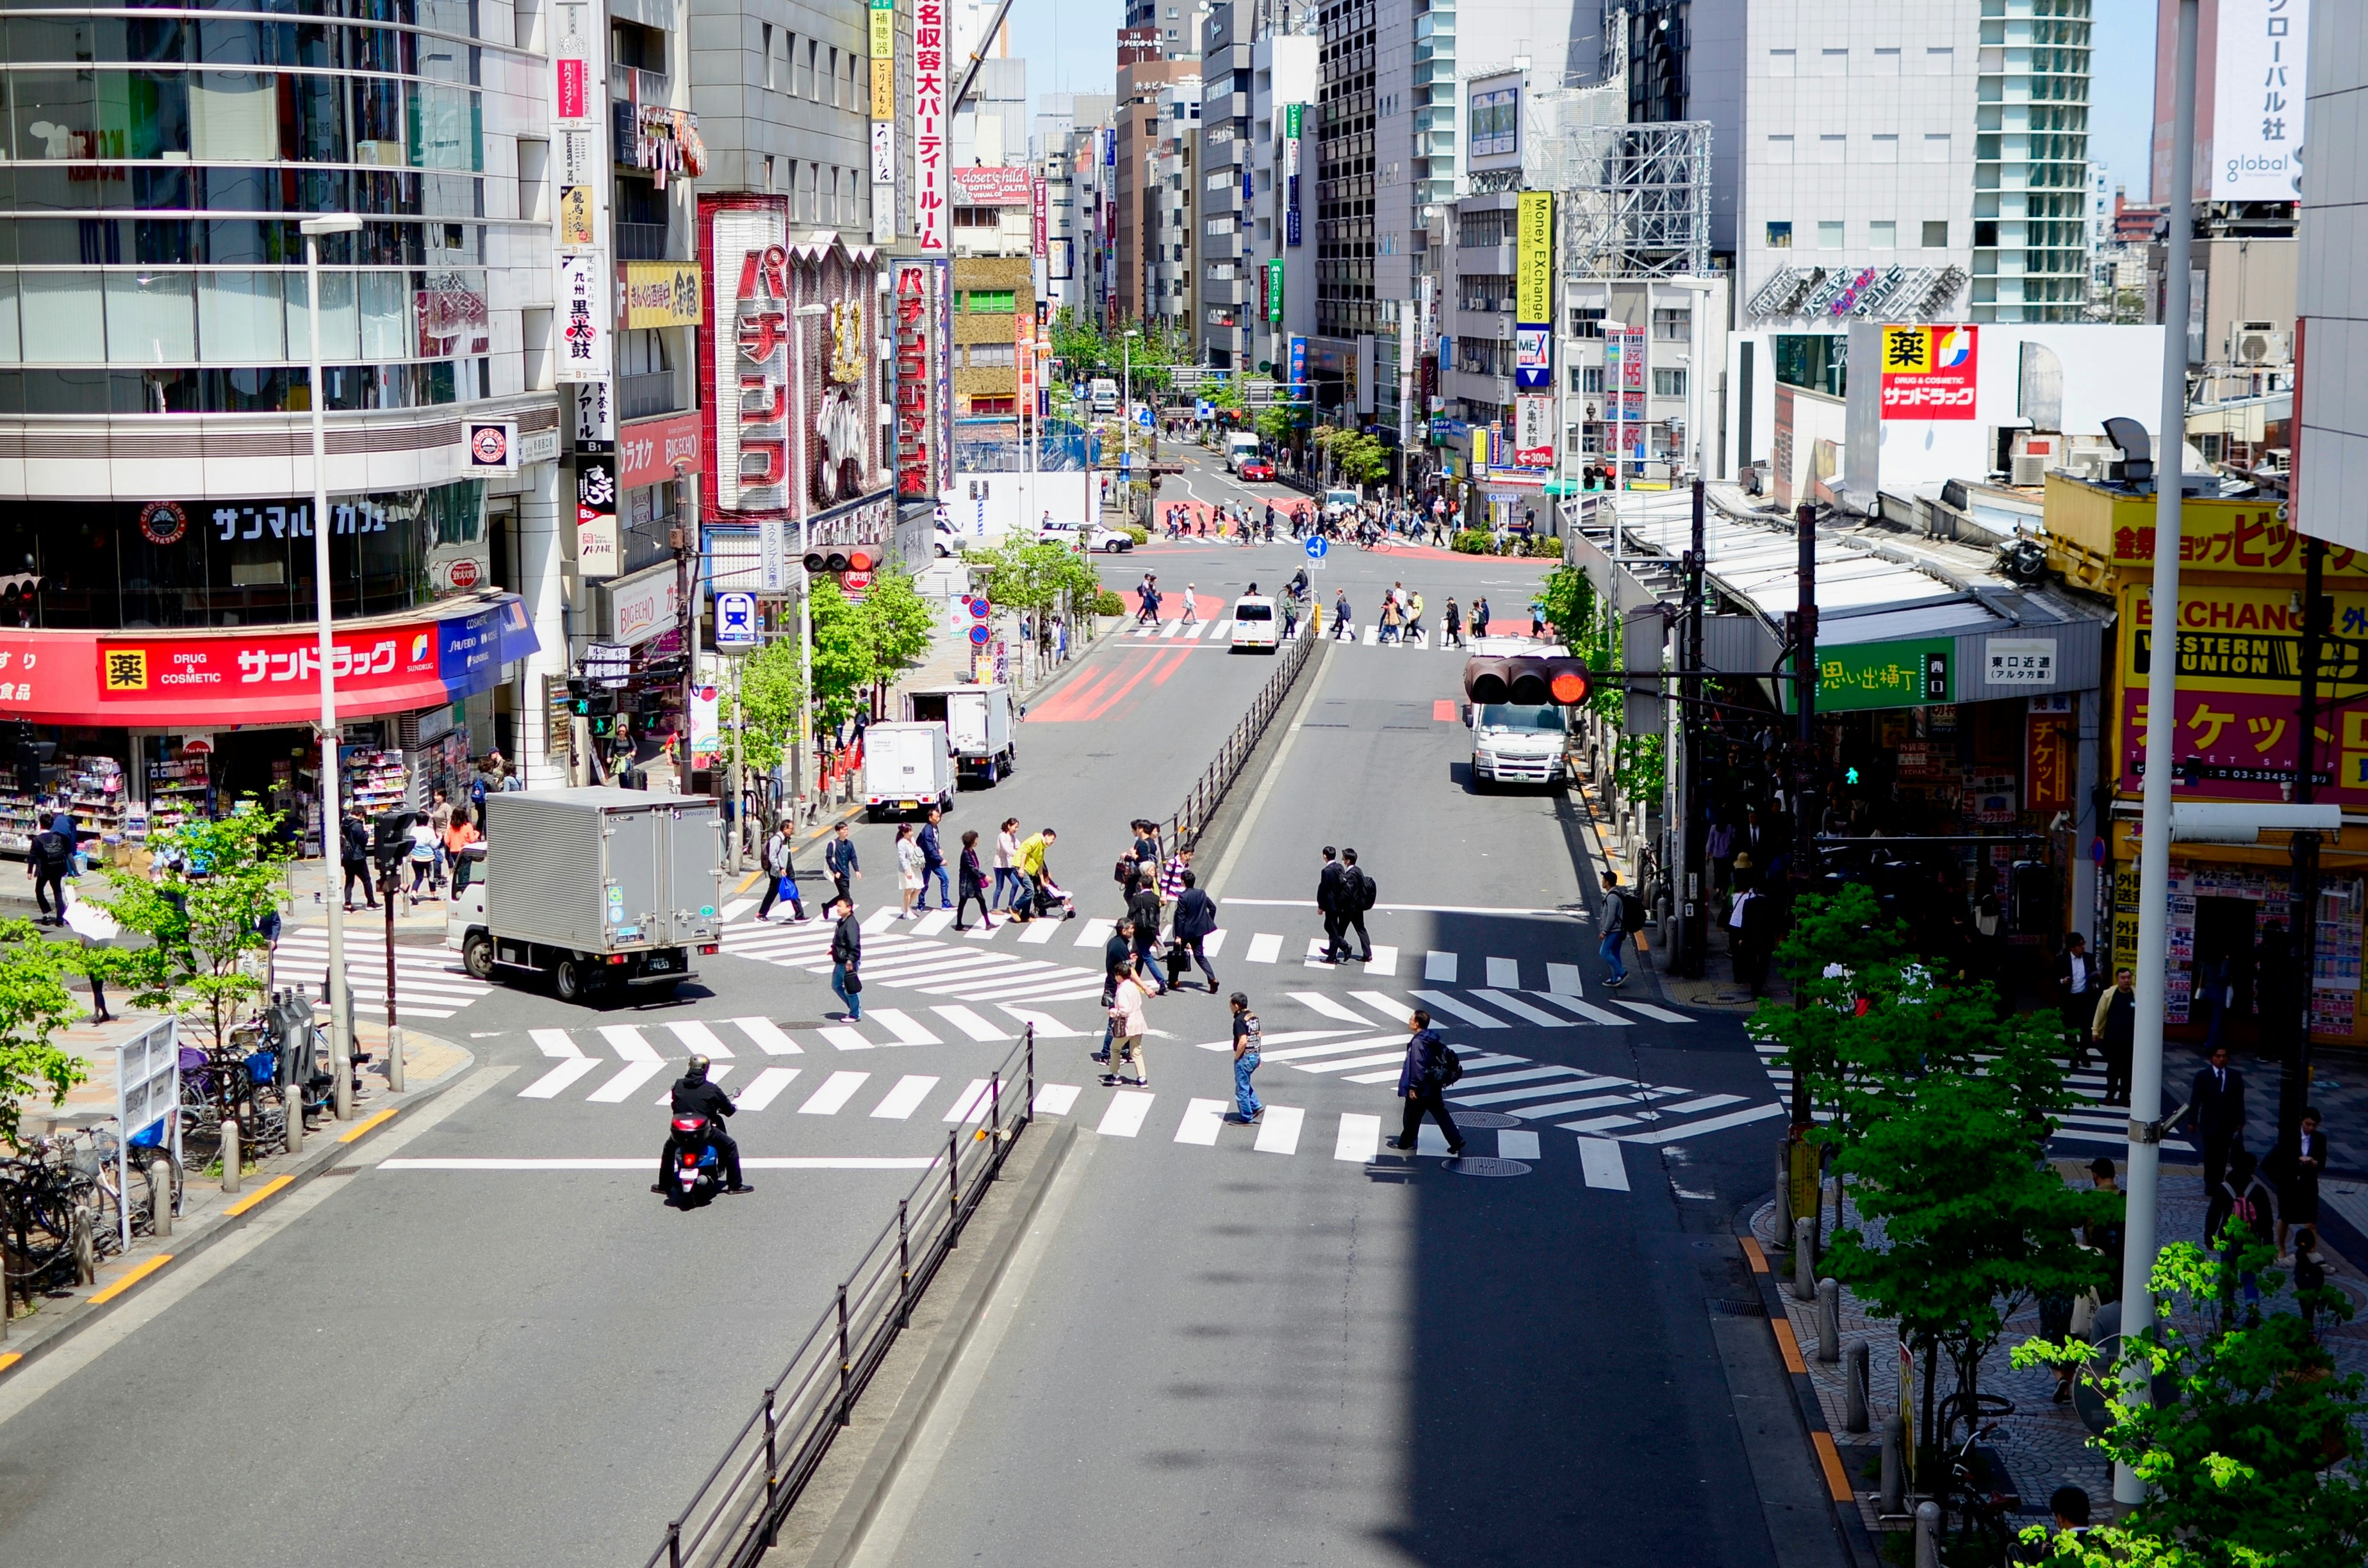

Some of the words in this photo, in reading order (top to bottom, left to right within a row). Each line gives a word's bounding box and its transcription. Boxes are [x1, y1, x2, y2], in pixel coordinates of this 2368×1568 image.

[876, 12, 888, 54] 補聴器
[564, 63, 573, 116] ハウスメイト
[878, 63, 887, 114] とりえもん
[2227, 154, 2287, 182] global
[1534, 199, 1547, 244] Money
[1518, 334, 1547, 363] MEX
[1889, 331, 1924, 366] 薬
[735, 244, 789, 488] パチンコ
[1884, 387, 1975, 405] サンドラッグ
[1526, 398, 1538, 447] 丸亀製麺
[588, 442, 602, 452] B1
[621, 438, 653, 474] カラオケ
[1531, 453, 1551, 463] 300m
[213, 502, 386, 541] サンマルカフェ
[767, 524, 778, 588] スクランブル交差点
[466, 614, 488, 630] COSMETIC
[174, 653, 207, 664] DRUG
[448, 637, 477, 653] SHISEIDO
[472, 651, 489, 664] SUNDRUG
[110, 654, 142, 686] 薬
[238, 641, 397, 683] サンドラッグ
[406, 662, 434, 672] SUNDRUG
[1822, 660, 1916, 691] 思い出横丁
[1931, 660, 1944, 692] 西口
[1991, 656, 2050, 668] 東口近道
[1991, 670, 2051, 680] (アルタ方面)
[2182, 654, 2269, 674] UNION
[161, 673, 221, 684] COSMETIC
[2033, 721, 2055, 801] チケット
[653, 961, 669, 969] 46-53
